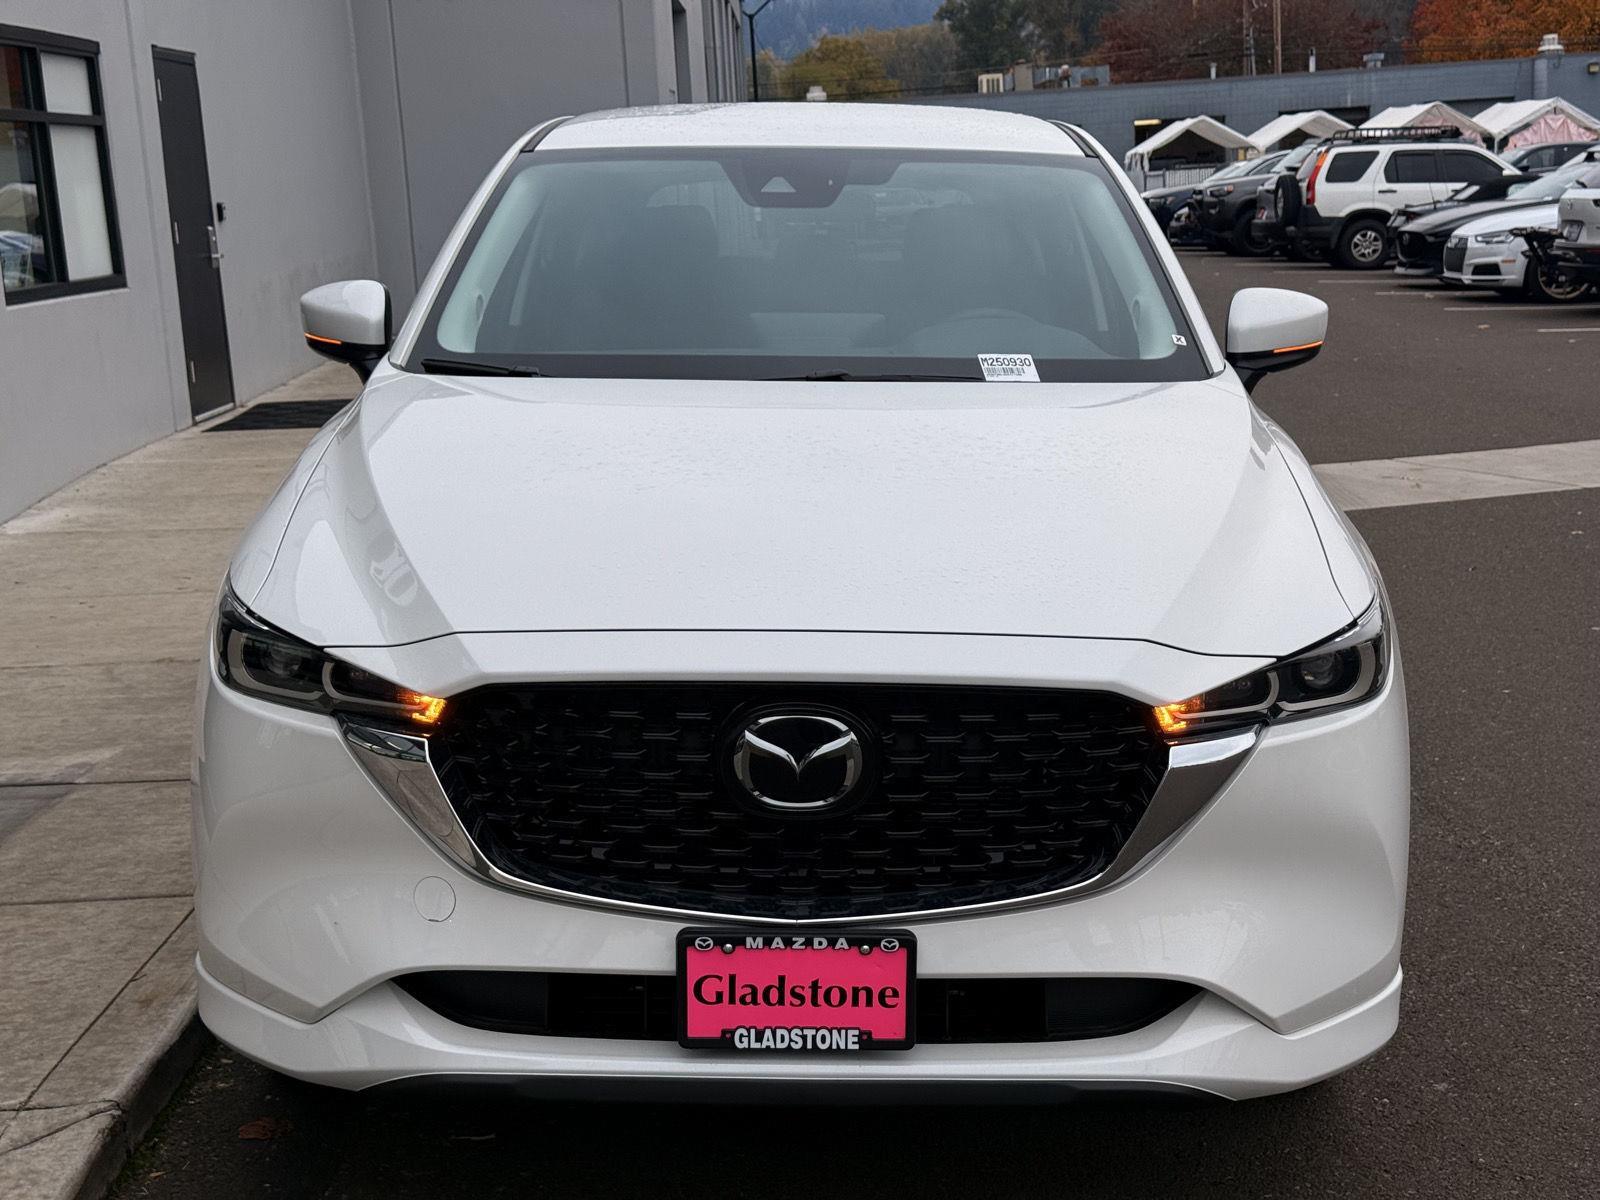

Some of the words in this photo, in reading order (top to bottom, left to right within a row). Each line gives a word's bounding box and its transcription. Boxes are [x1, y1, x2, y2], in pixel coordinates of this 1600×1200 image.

[980, 357, 1032, 367] M250930
[745, 936, 850, 950] MAZDA
[692, 973, 901, 1009] Gladstone
[733, 1027, 860, 1050] GLADSTONE
